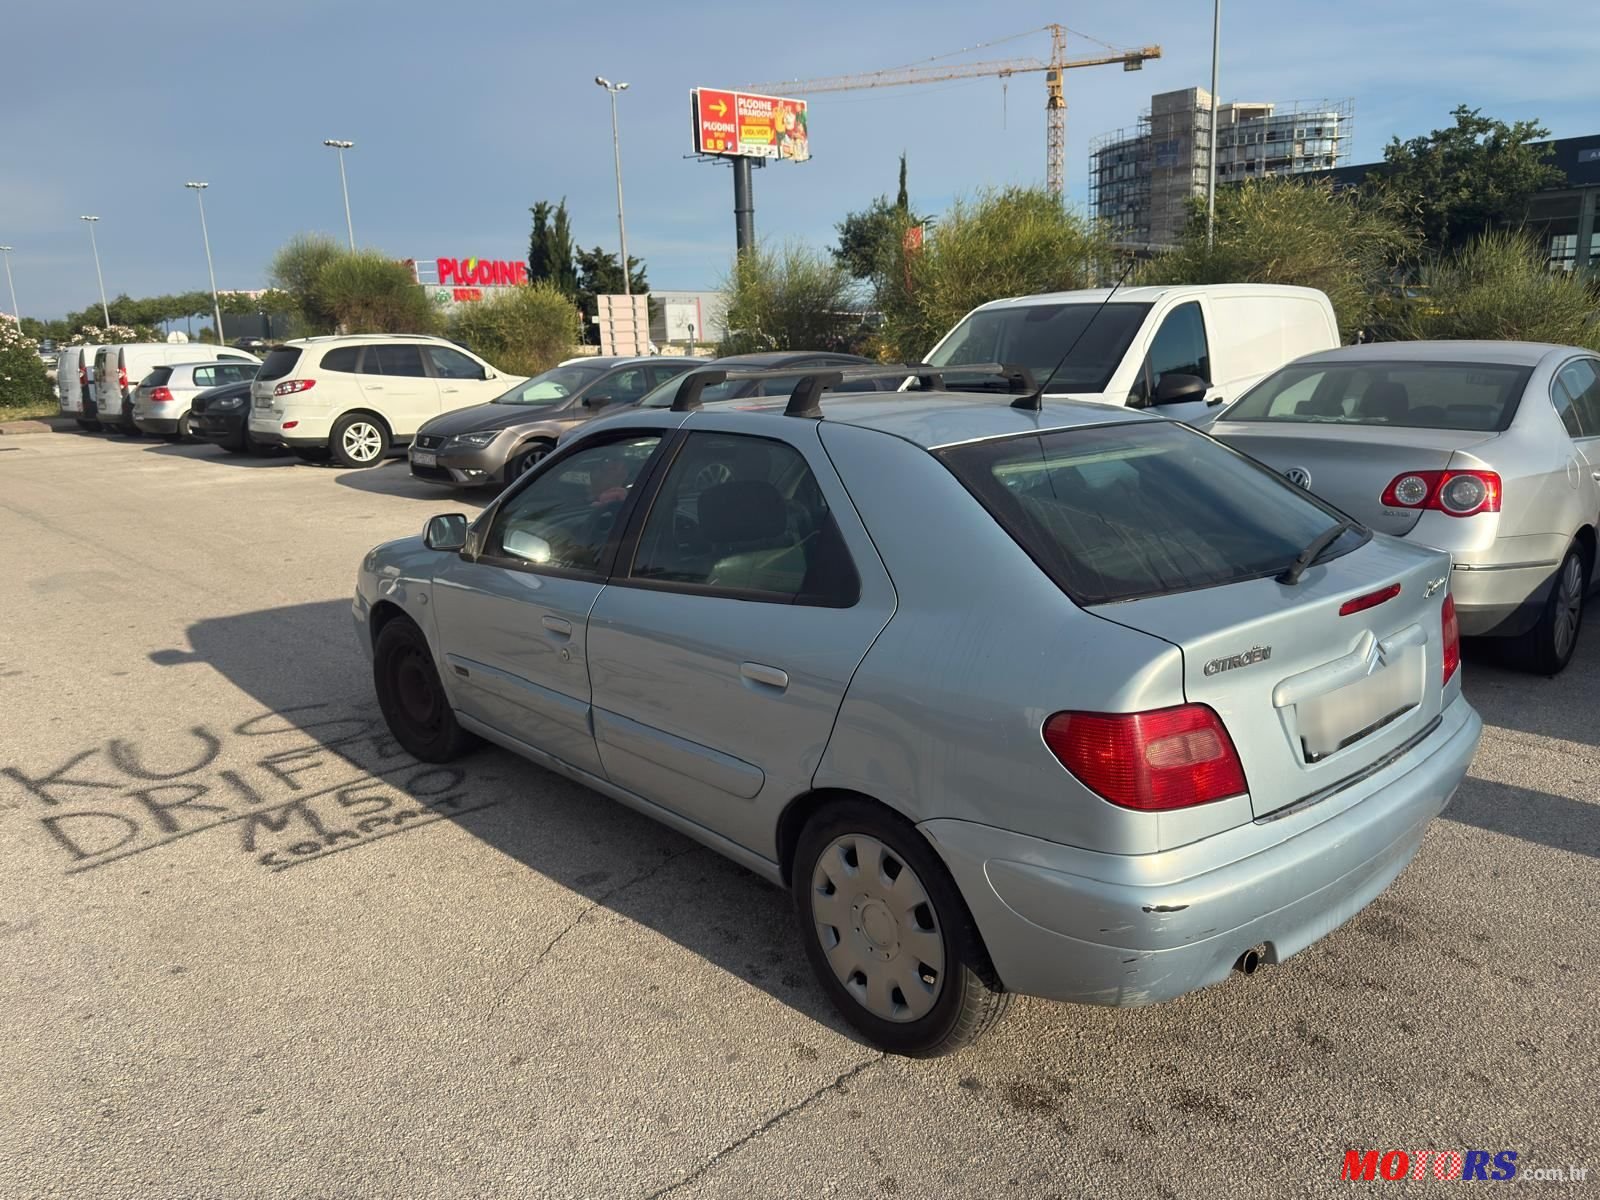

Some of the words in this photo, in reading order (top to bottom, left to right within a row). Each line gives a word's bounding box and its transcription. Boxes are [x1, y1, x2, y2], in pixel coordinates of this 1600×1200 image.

[738, 98, 772, 111] PLODINE
[702, 121, 735, 133] PLODINE
[437, 258, 528, 286] PLODINE
[1203, 645, 1272, 676] CITROËN
[2, 702, 382, 806] KUS
